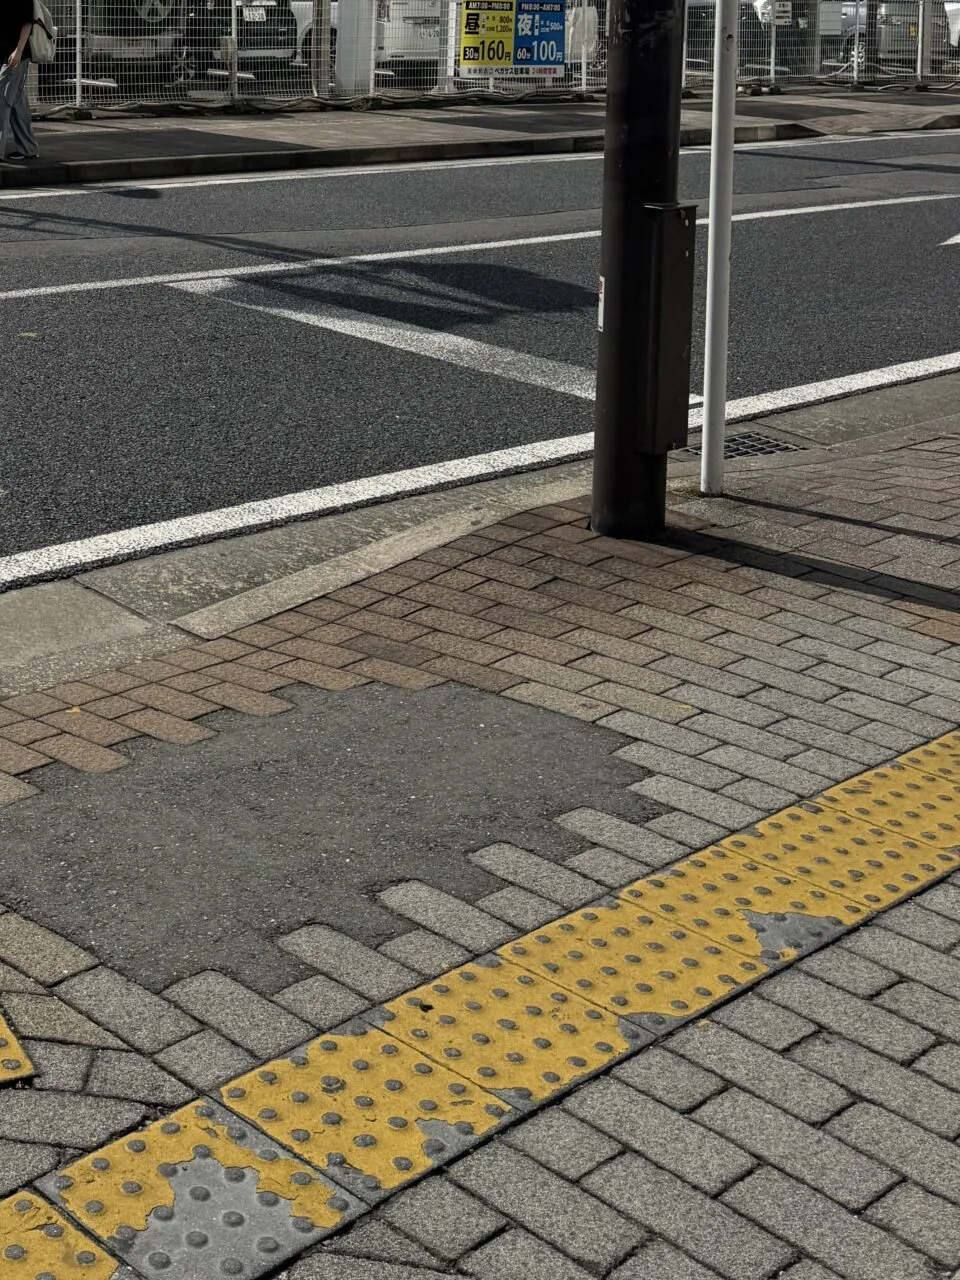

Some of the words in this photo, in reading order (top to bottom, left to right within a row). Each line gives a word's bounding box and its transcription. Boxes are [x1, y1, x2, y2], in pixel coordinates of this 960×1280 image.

[464, 13, 480, 34] 昼
[517, 13, 533, 36] 夜
[480, 40, 511, 62] 160円
[532, 40, 563, 62] 100円
